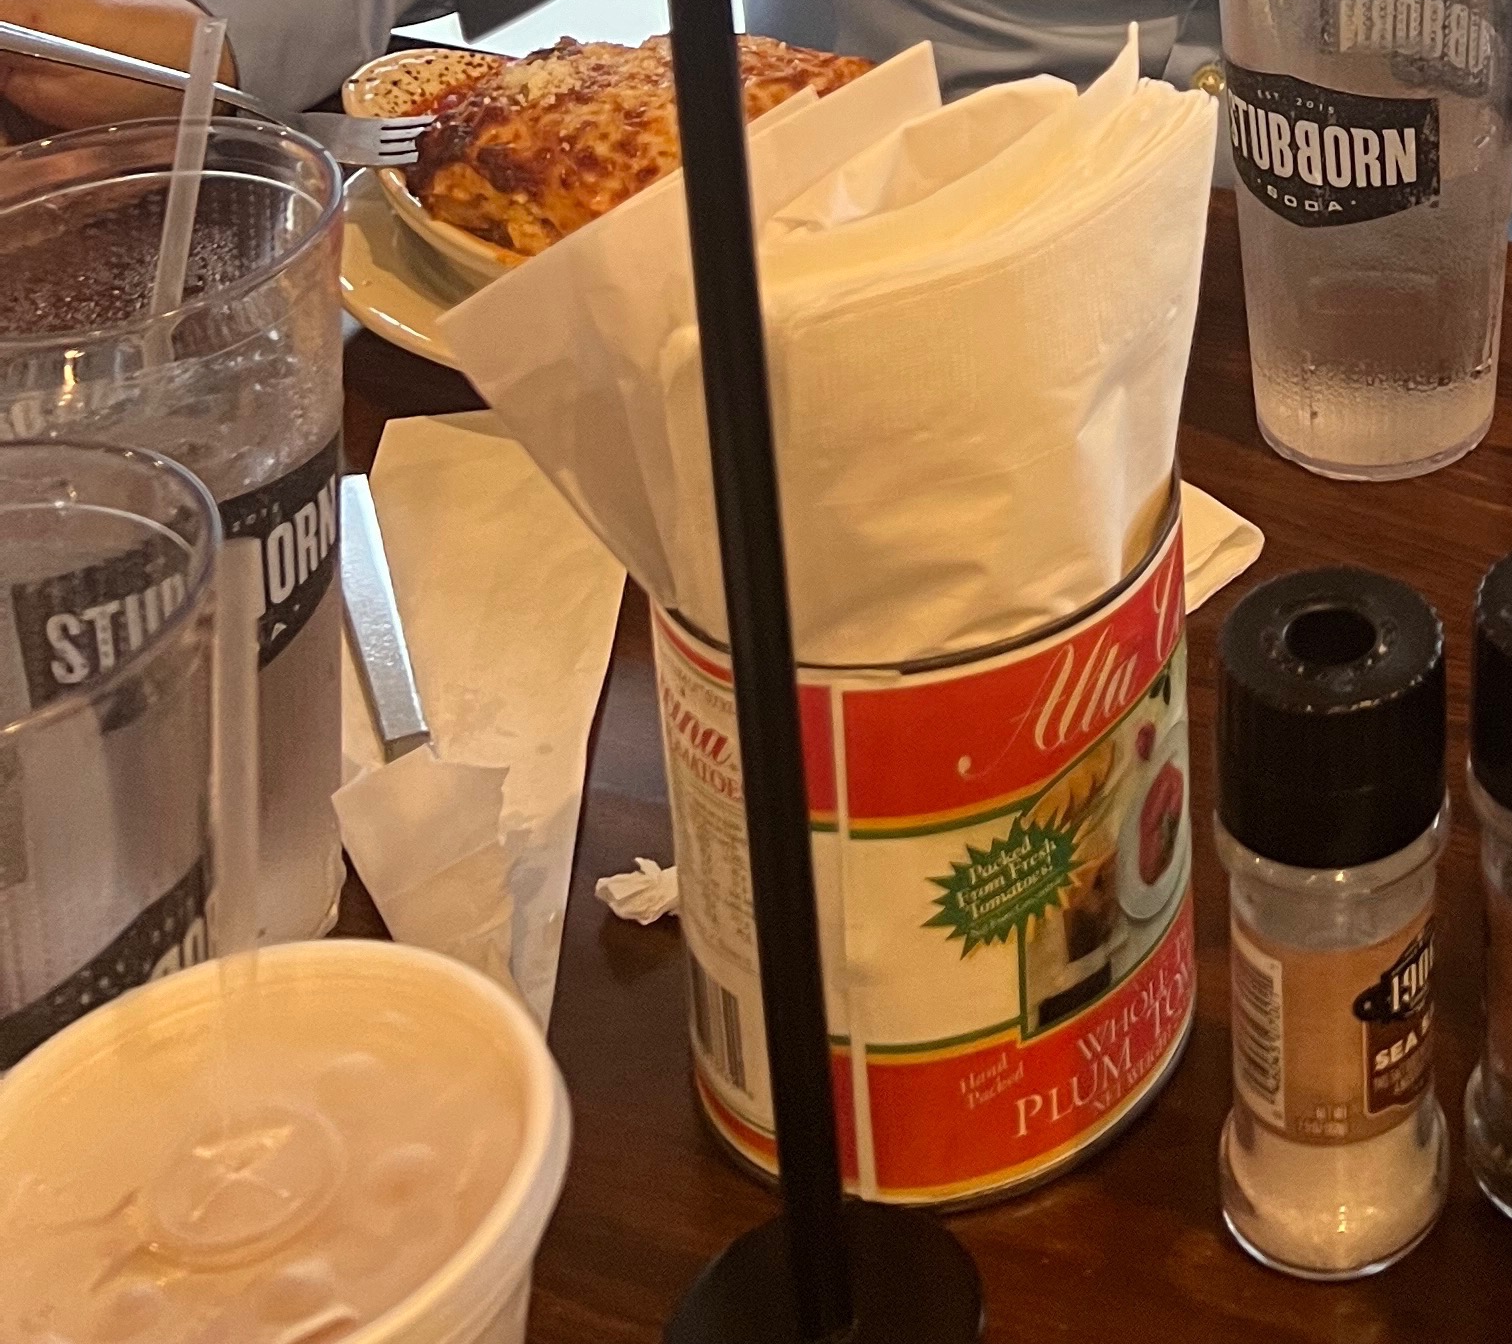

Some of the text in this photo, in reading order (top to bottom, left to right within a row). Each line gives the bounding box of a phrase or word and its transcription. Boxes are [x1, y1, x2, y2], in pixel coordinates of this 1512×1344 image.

[1228, 88, 1417, 189] STUBBORN
[1266, 184, 1343, 212] SODA
[968, 834, 1032, 885] Packed
[1008, 838, 1057, 880] Fresh
[1374, 1029, 1418, 1072] SEA
[1014, 1036, 1133, 1138] PLUM
